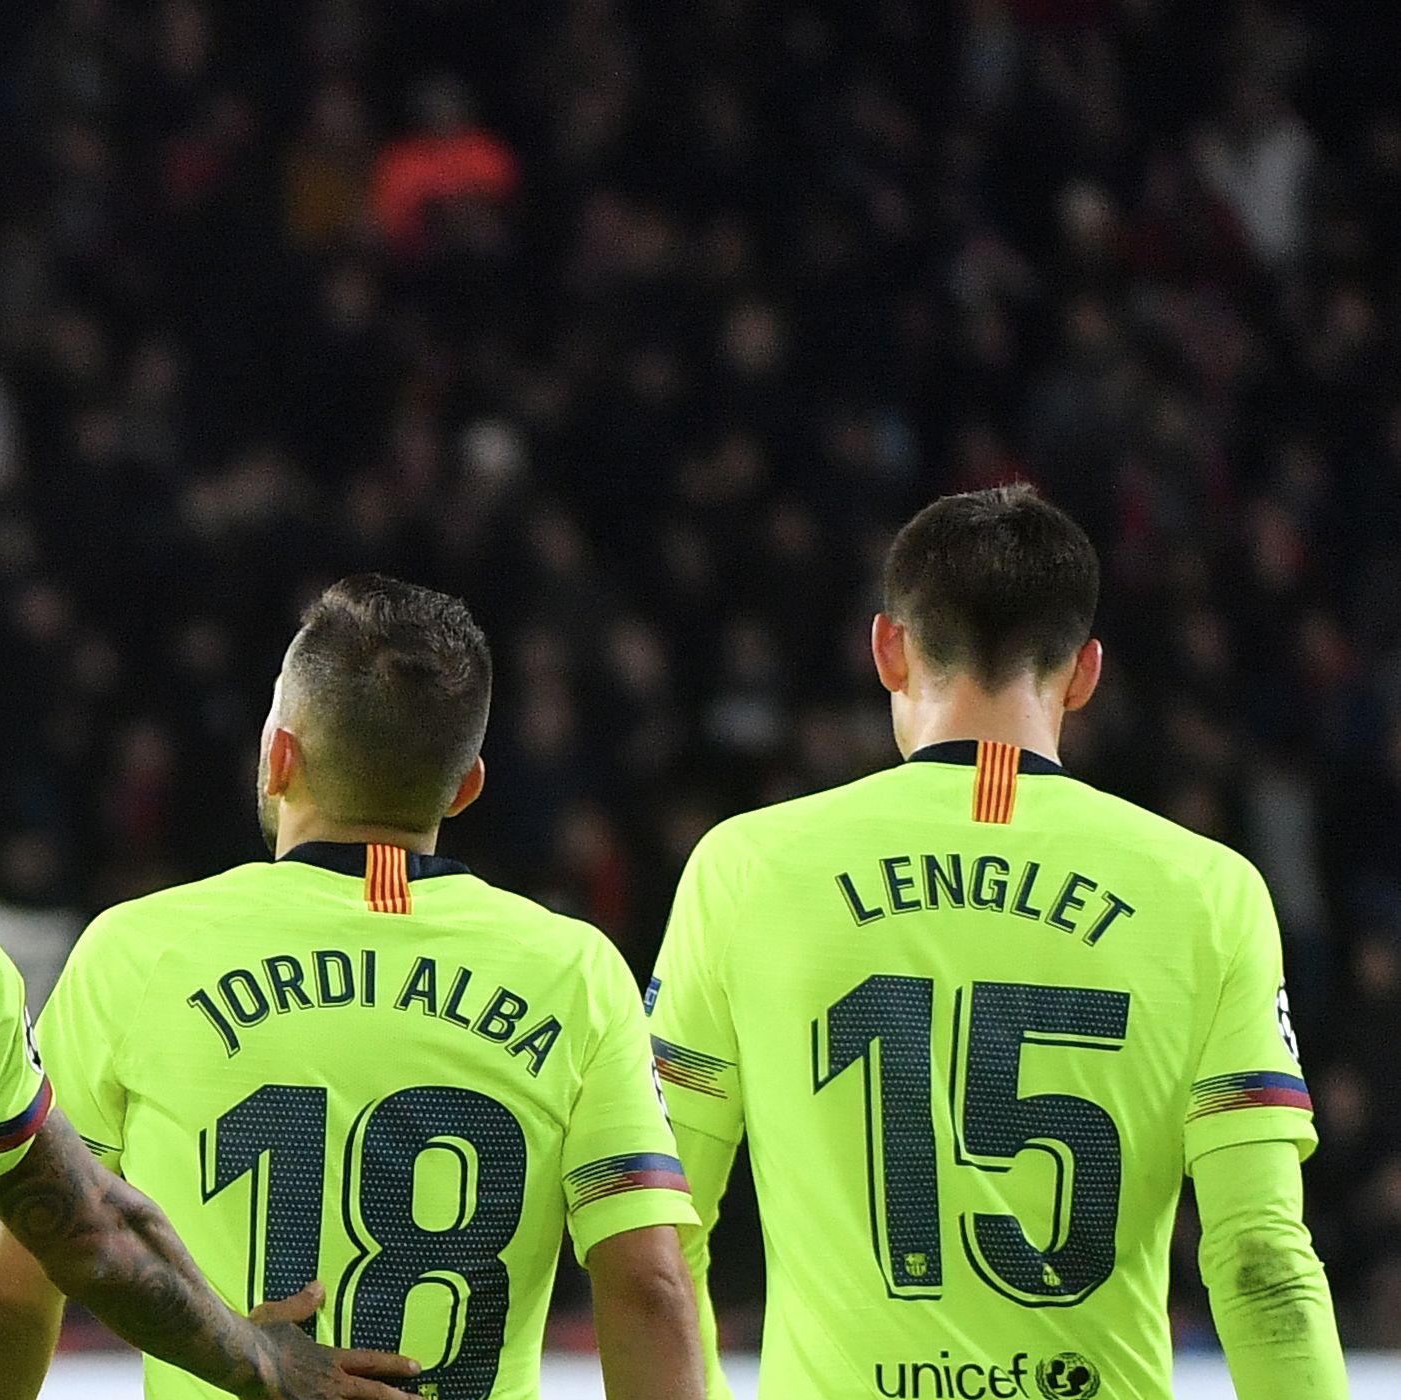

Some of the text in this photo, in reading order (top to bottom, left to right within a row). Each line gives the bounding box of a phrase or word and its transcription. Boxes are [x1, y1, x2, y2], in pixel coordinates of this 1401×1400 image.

[836, 853, 1135, 946] LENGLET
[187, 950, 565, 1077] JORDI ALBA
[811, 974, 1131, 1308] 15
[875, 1351, 1029, 1400] unicef
